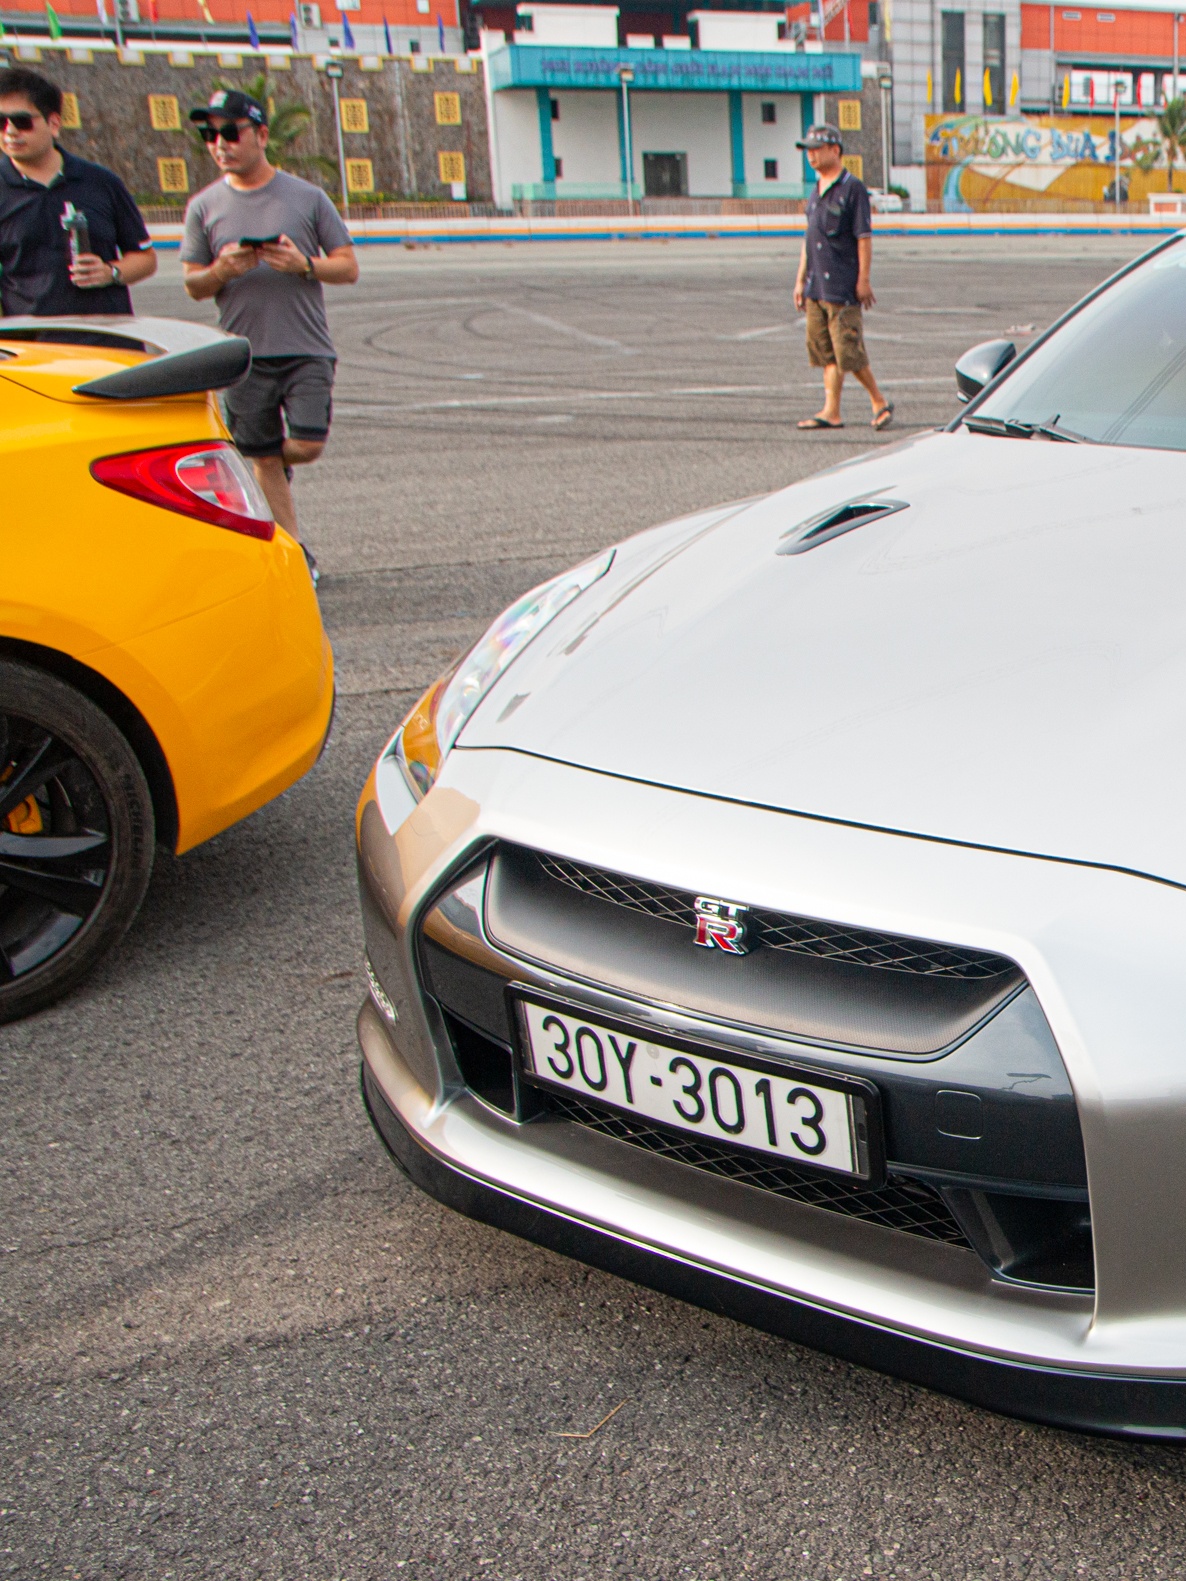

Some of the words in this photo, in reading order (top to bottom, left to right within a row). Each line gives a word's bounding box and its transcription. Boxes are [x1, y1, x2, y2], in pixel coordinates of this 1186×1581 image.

[694, 896, 749, 918] GT
[693, 914, 746, 955] R
[542, 1015, 827, 1156] 30Y-3013
